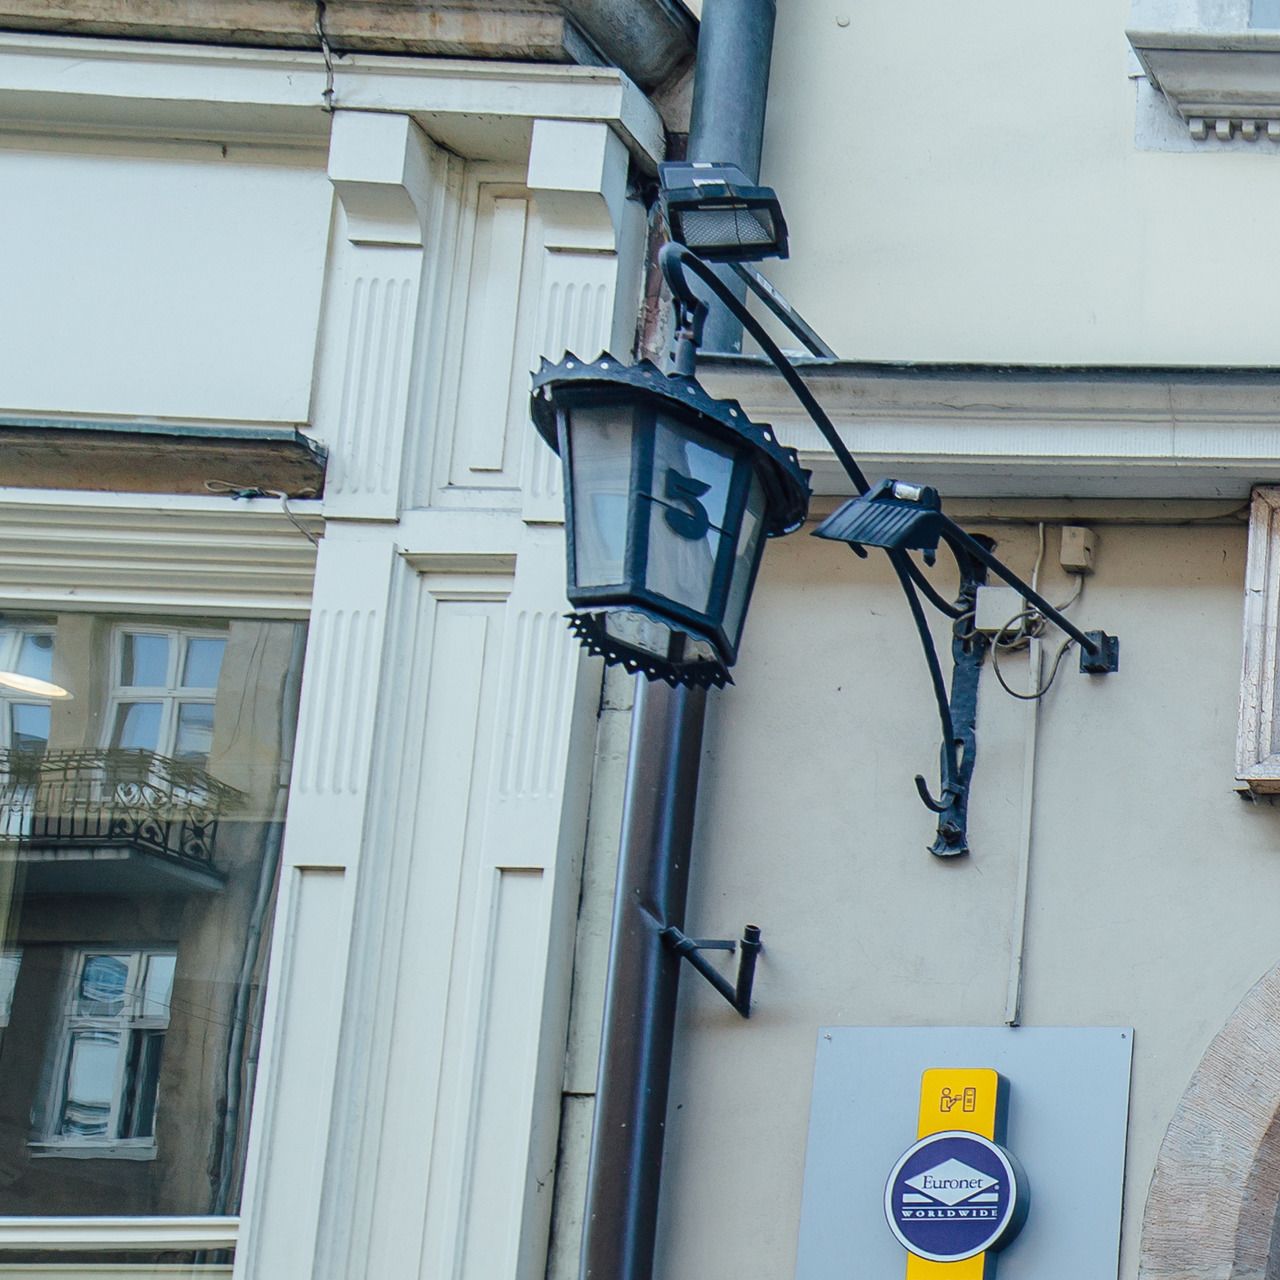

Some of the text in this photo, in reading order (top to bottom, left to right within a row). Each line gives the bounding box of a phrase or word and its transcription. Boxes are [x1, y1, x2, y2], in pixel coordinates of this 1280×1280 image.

[666, 467, 712, 541] 5
[922, 1175, 983, 1190] Euronet
[901, 1209, 998, 1218] WORLDWIDE
